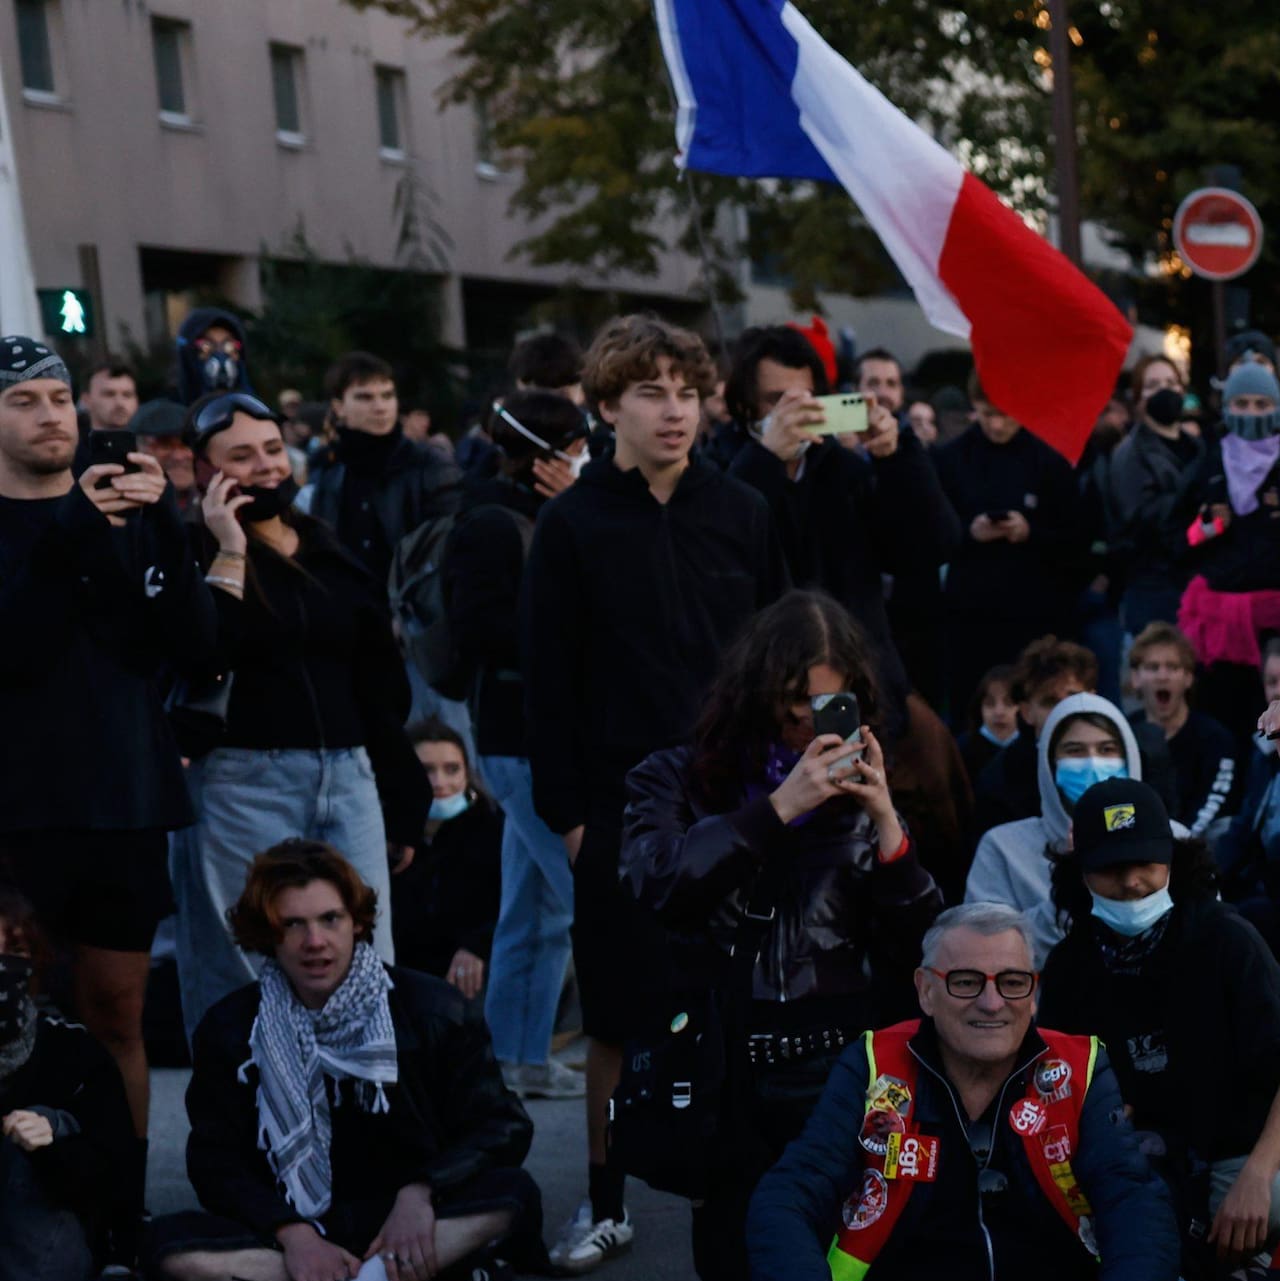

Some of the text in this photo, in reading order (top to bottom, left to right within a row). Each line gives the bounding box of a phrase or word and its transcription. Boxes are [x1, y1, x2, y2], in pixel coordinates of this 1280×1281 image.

[1041, 1063, 1068, 1085] cgt
[1015, 1101, 1040, 1131] cgt
[898, 1138, 919, 1178] cgt
[1043, 1135, 1071, 1163] cgt
